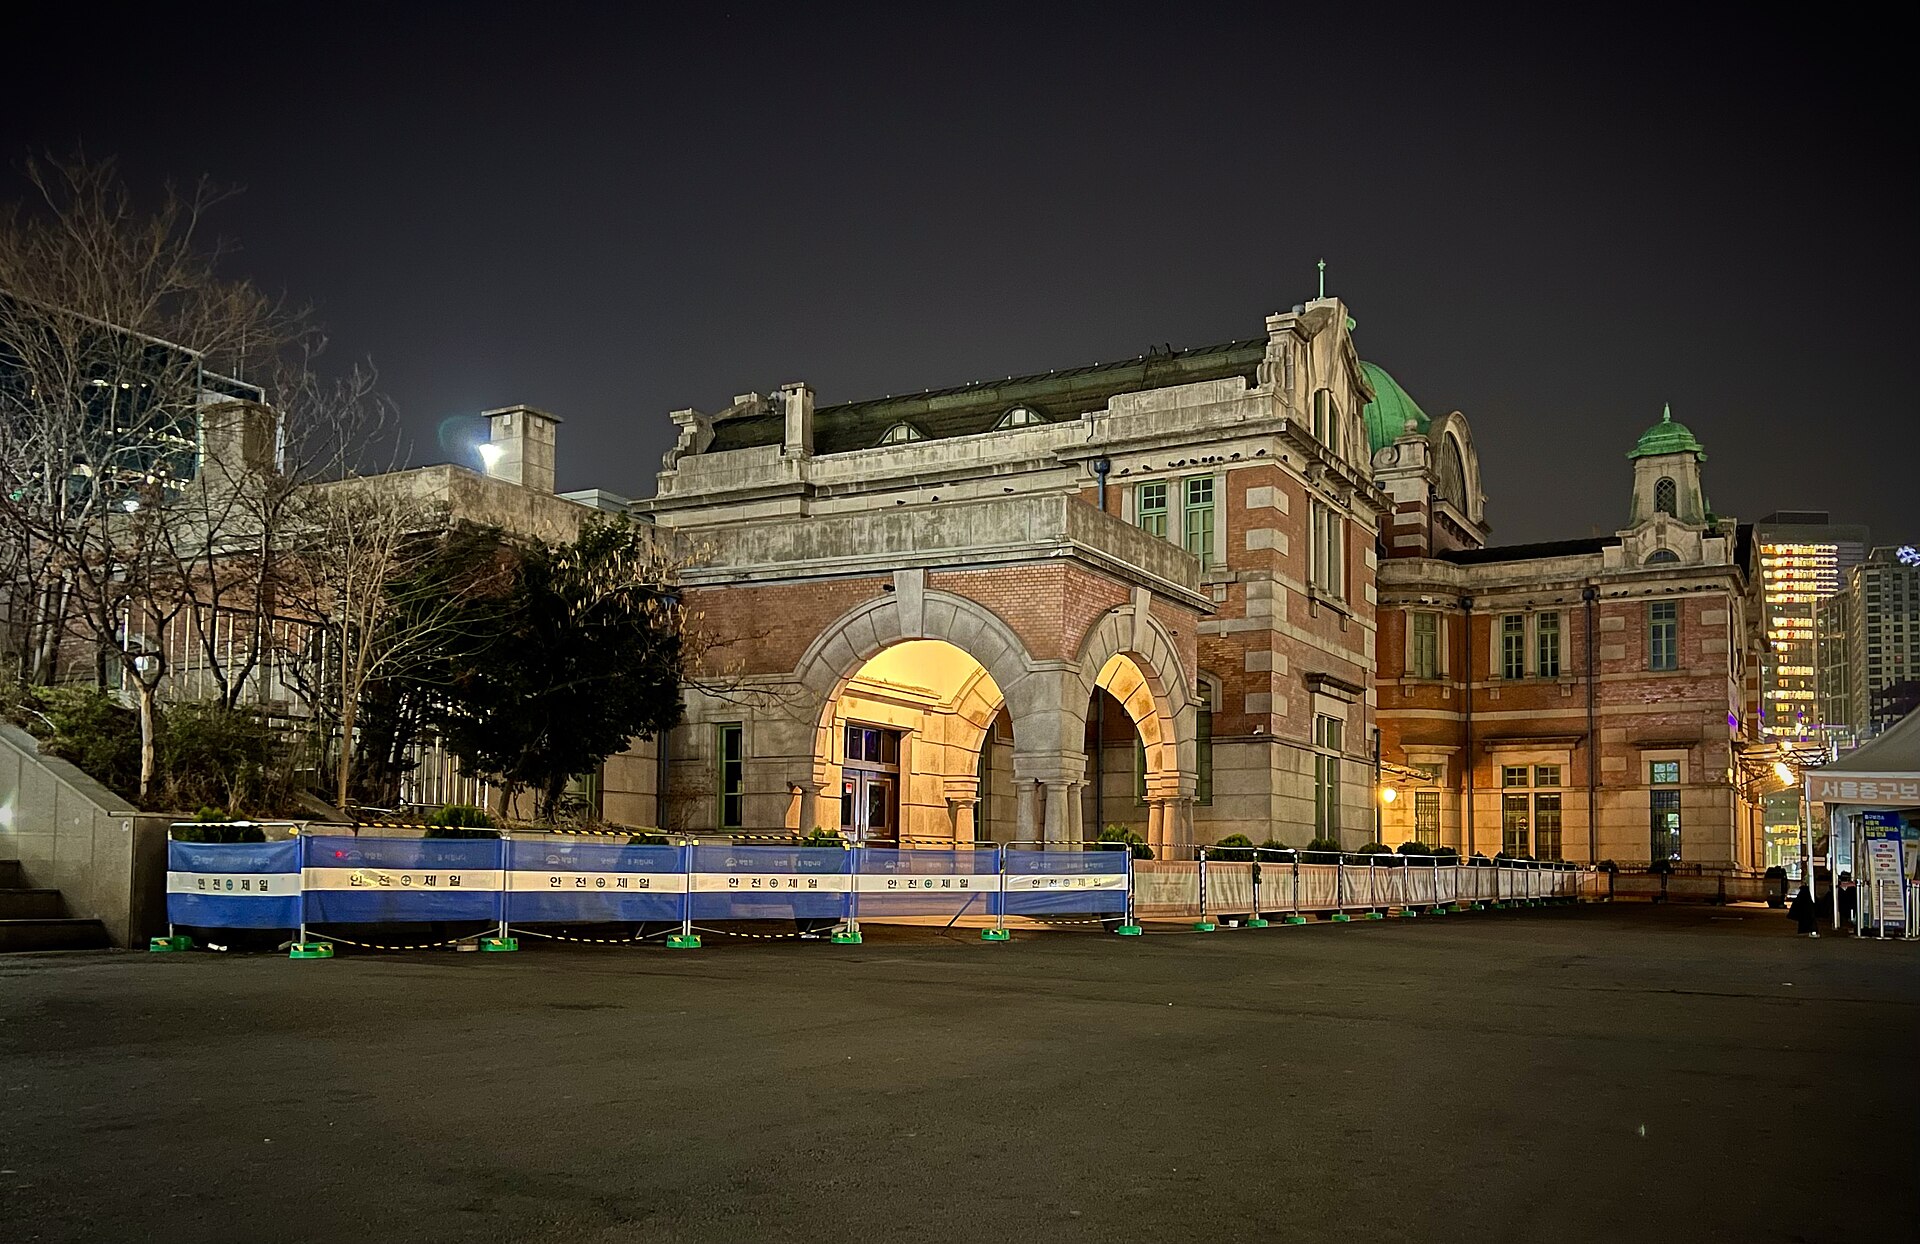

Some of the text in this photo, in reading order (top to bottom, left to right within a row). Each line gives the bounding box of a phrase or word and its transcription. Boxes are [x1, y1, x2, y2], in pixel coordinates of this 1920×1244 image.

[1821, 781, 1919, 800] 서울중구보
[241, 879, 268, 891] 제일
[423, 875, 461, 887] 제일
[550, 876, 650, 889] 안전 제일
[728, 877, 818, 889] 안전 제일
[887, 879, 969, 889] 안전 제일
